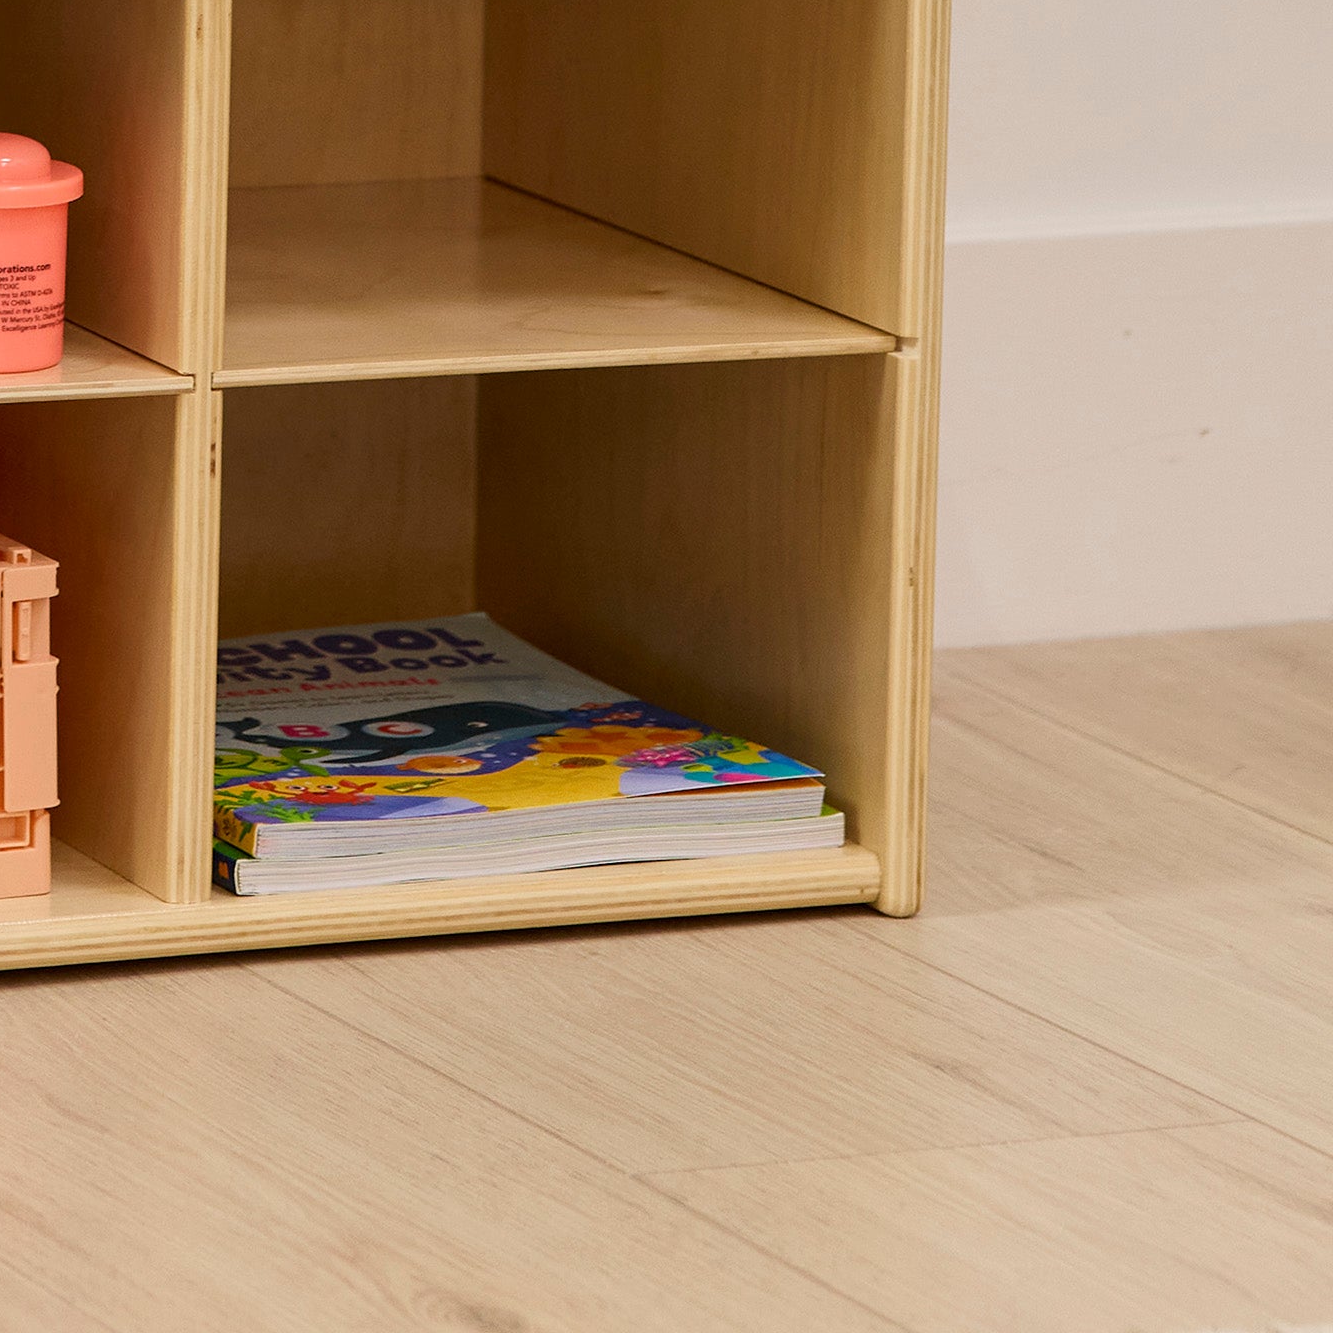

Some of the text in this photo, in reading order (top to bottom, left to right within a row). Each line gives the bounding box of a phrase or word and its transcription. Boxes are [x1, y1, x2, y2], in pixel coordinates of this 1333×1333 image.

[217, 627, 484, 667] CHOOL
[337, 648, 510, 674] Book
[277, 723, 423, 739] B C
